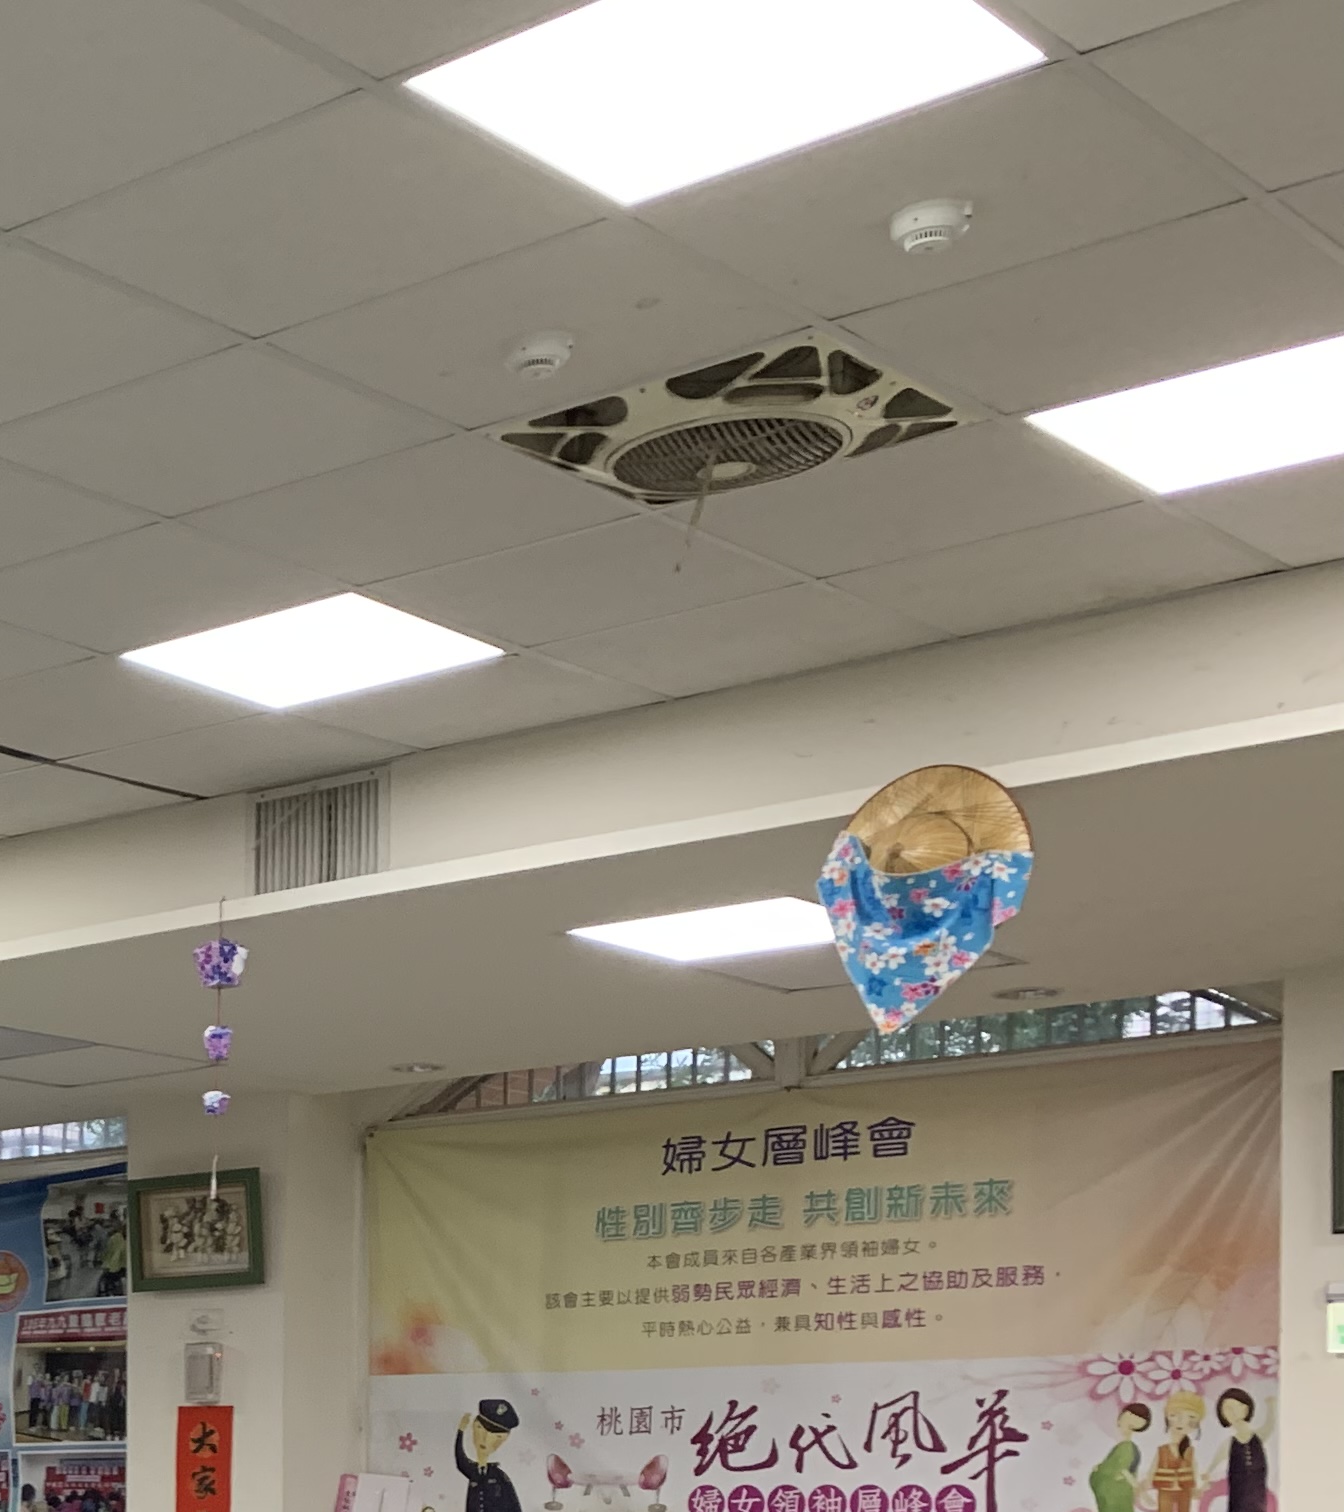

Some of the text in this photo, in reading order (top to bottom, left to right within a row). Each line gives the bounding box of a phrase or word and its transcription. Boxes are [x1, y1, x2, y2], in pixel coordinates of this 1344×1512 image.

[662, 1116, 916, 1176] 婦女層峰會
[595, 1177, 1015, 1242] 性別齊步走 共創新未來
[596, 1405, 686, 1436] 桃園市
